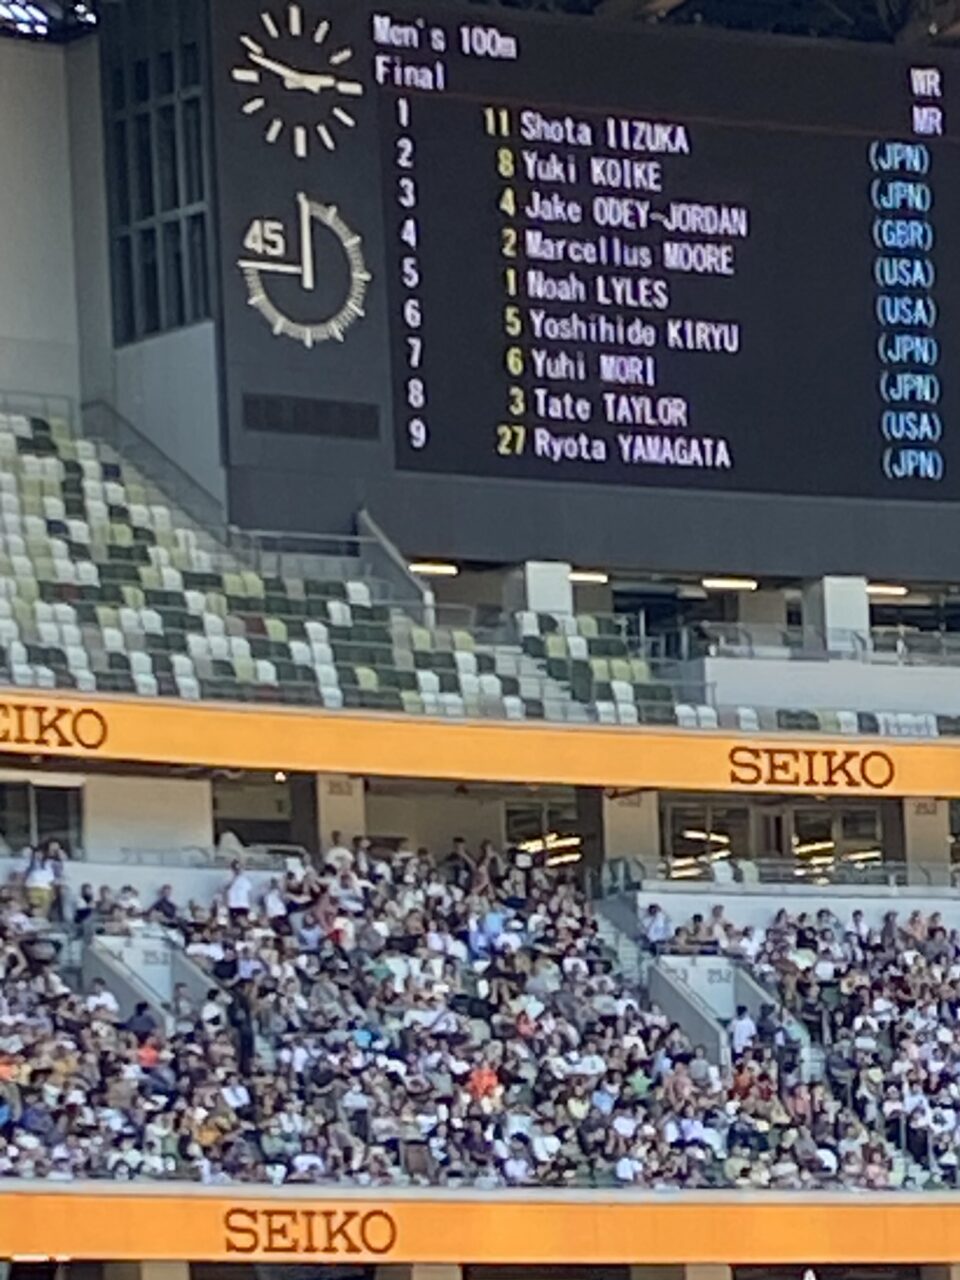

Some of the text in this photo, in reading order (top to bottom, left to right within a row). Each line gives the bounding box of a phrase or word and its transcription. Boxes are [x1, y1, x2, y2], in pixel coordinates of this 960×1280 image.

[374, 15, 516, 57] Men's 100m
[376, 56, 444, 89] Final
[911, 69, 941, 96] WR
[399, 99, 408, 126] 1
[486, 108, 508, 136] 11
[521, 111, 591, 145] Shota
[869, 142, 930, 173] (JPN)
[398, 138, 931, 211] 2 8 Yuki KOIKE (JPN)
[243, 220, 284, 256] 45
[400, 178, 414, 207] 3
[501, 189, 514, 215] 4
[526, 191, 581, 222] Jake
[873, 219, 933, 250] (GBR)
[402, 219, 934, 289] 4 2 Marcellus MOORE (USA)
[404, 258, 936, 327] 5 1 Noah LYLES (USA)
[405, 299, 937, 366] 6 5 Yoshihide KIRYU (JPN)
[408, 338, 939, 404] 7 6 Yuhi MORI (JPN)
[409, 379, 941, 442] 8 3 Tate TAYLOR (USA)
[410, 419, 943, 480] 9 27 Ryota YAMAGATA (JPN)
[728, 746, 896, 789] SEIKO
[224, 1208, 397, 1254] SEIKO
